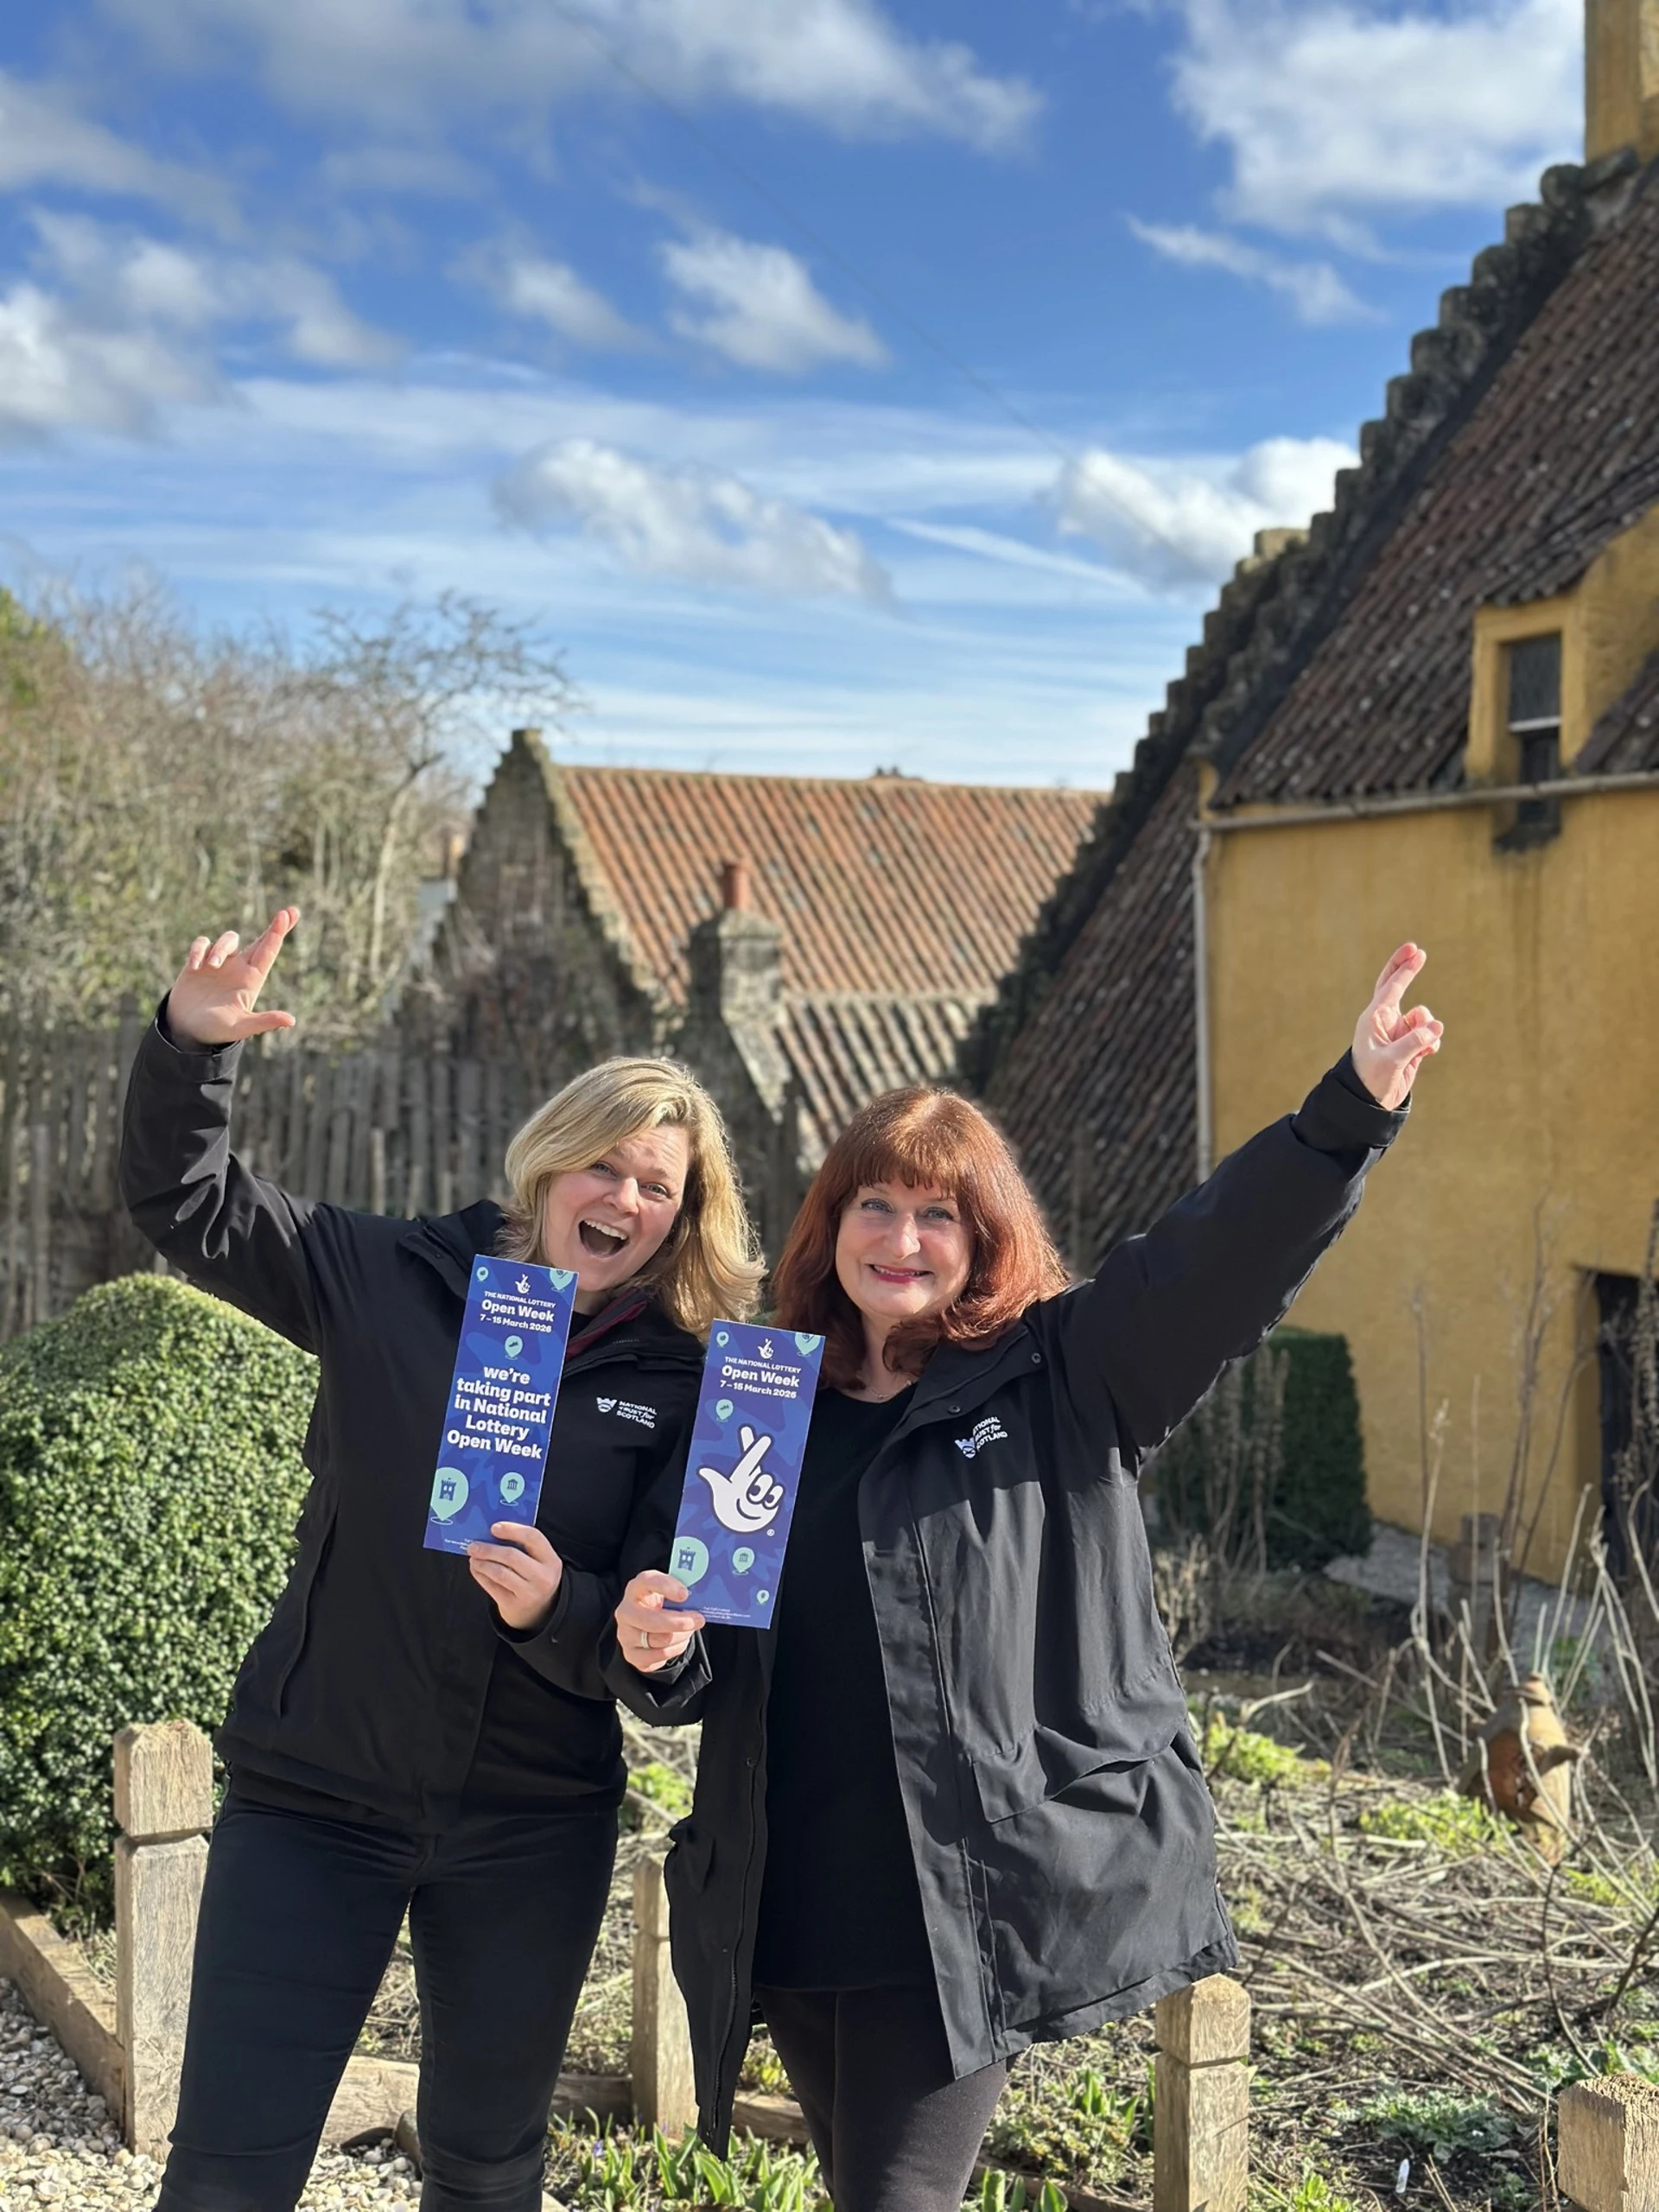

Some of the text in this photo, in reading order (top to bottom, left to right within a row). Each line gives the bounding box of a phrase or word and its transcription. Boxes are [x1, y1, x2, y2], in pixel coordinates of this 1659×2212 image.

[482, 1300, 555, 1322] Open Week
[497, 1294, 528, 1304] NATIONAL
[528, 1299, 556, 1308] LOTTERY
[502, 1318, 529, 1329] March
[529, 1323, 552, 1333] 2026
[721, 1364, 800, 1388] Open Week
[738, 1358, 771, 1370] NATIONAL
[772, 1363, 802, 1374] LOTTERY
[457, 1377, 551, 1407] taking part
[744, 1383, 772, 1395] March
[772, 1389, 797, 1399] 2026
[454, 1394, 547, 1424] in National
[619, 1401, 657, 1415] NATIONAL
[465, 1414, 530, 1441] Lottery
[616, 1410, 655, 1429] SCOTLAND
[447, 1429, 543, 1459] Open Week
